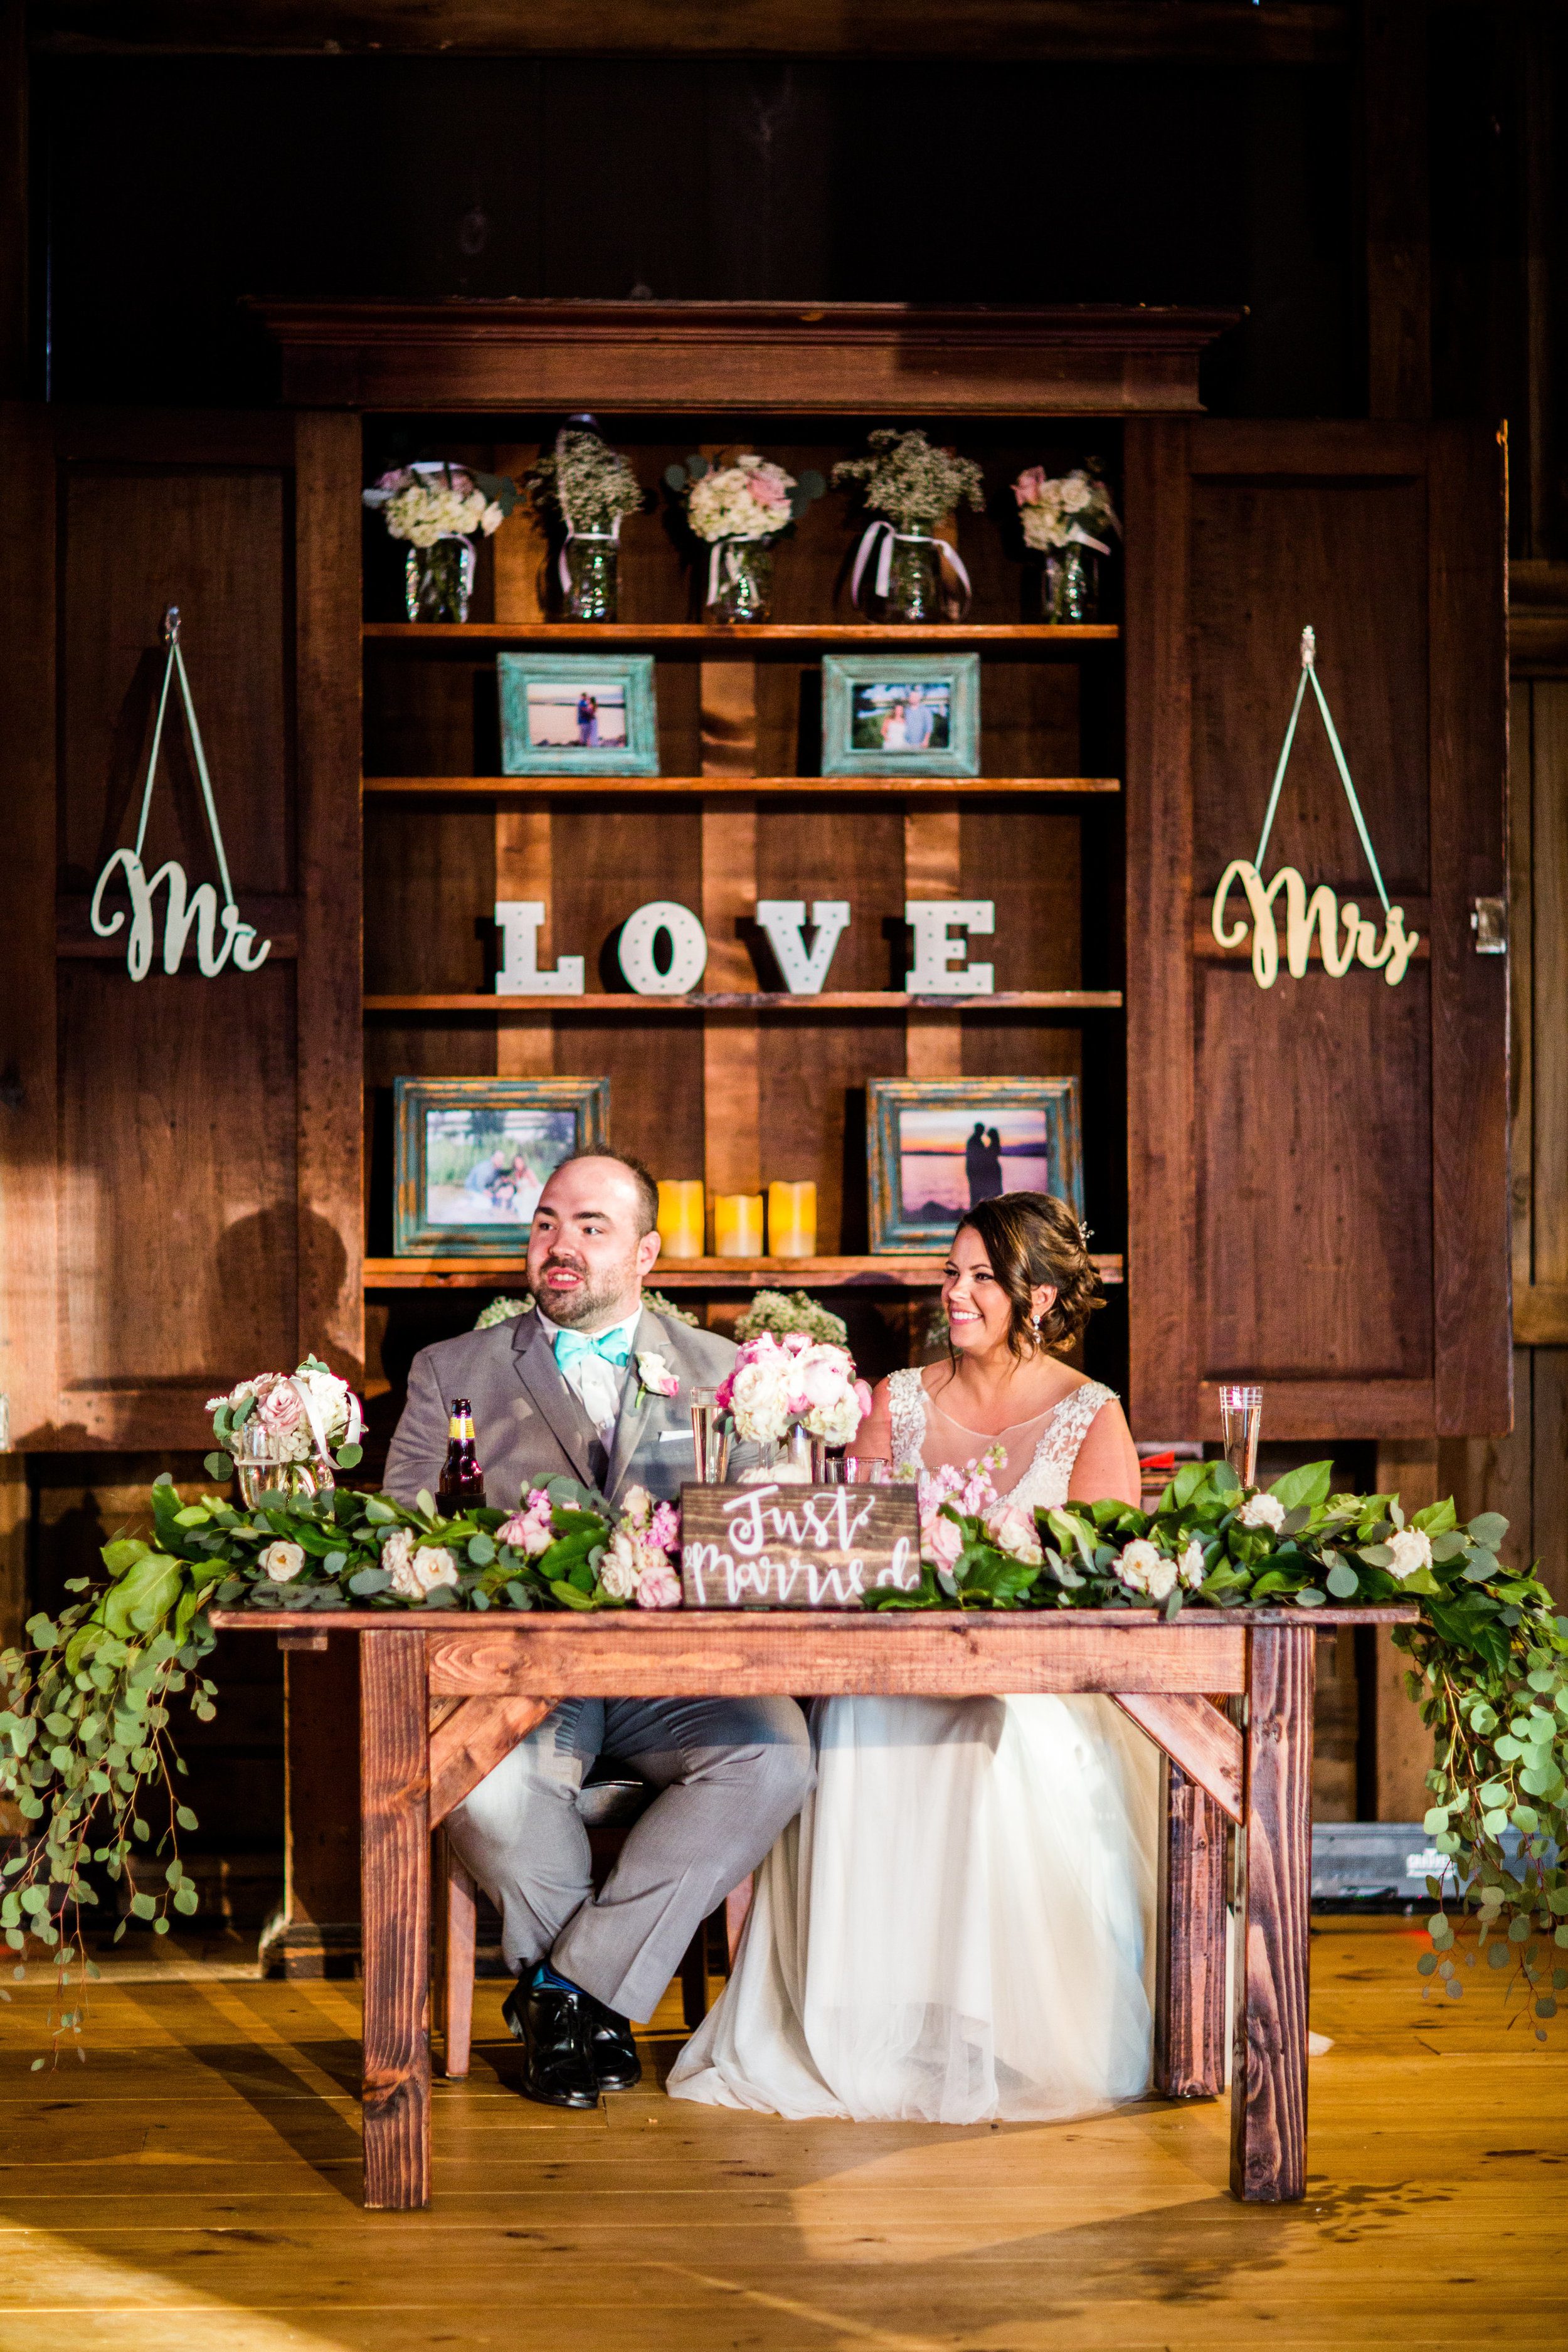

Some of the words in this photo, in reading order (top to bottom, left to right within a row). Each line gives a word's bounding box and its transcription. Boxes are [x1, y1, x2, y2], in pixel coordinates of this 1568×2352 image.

[90, 848, 272, 983] Mr
[494, 900, 995, 995] LOVE
[1211, 859, 1420, 990] Mrs
[723, 1484, 876, 1555] Just
[683, 1536, 920, 1604] Married
